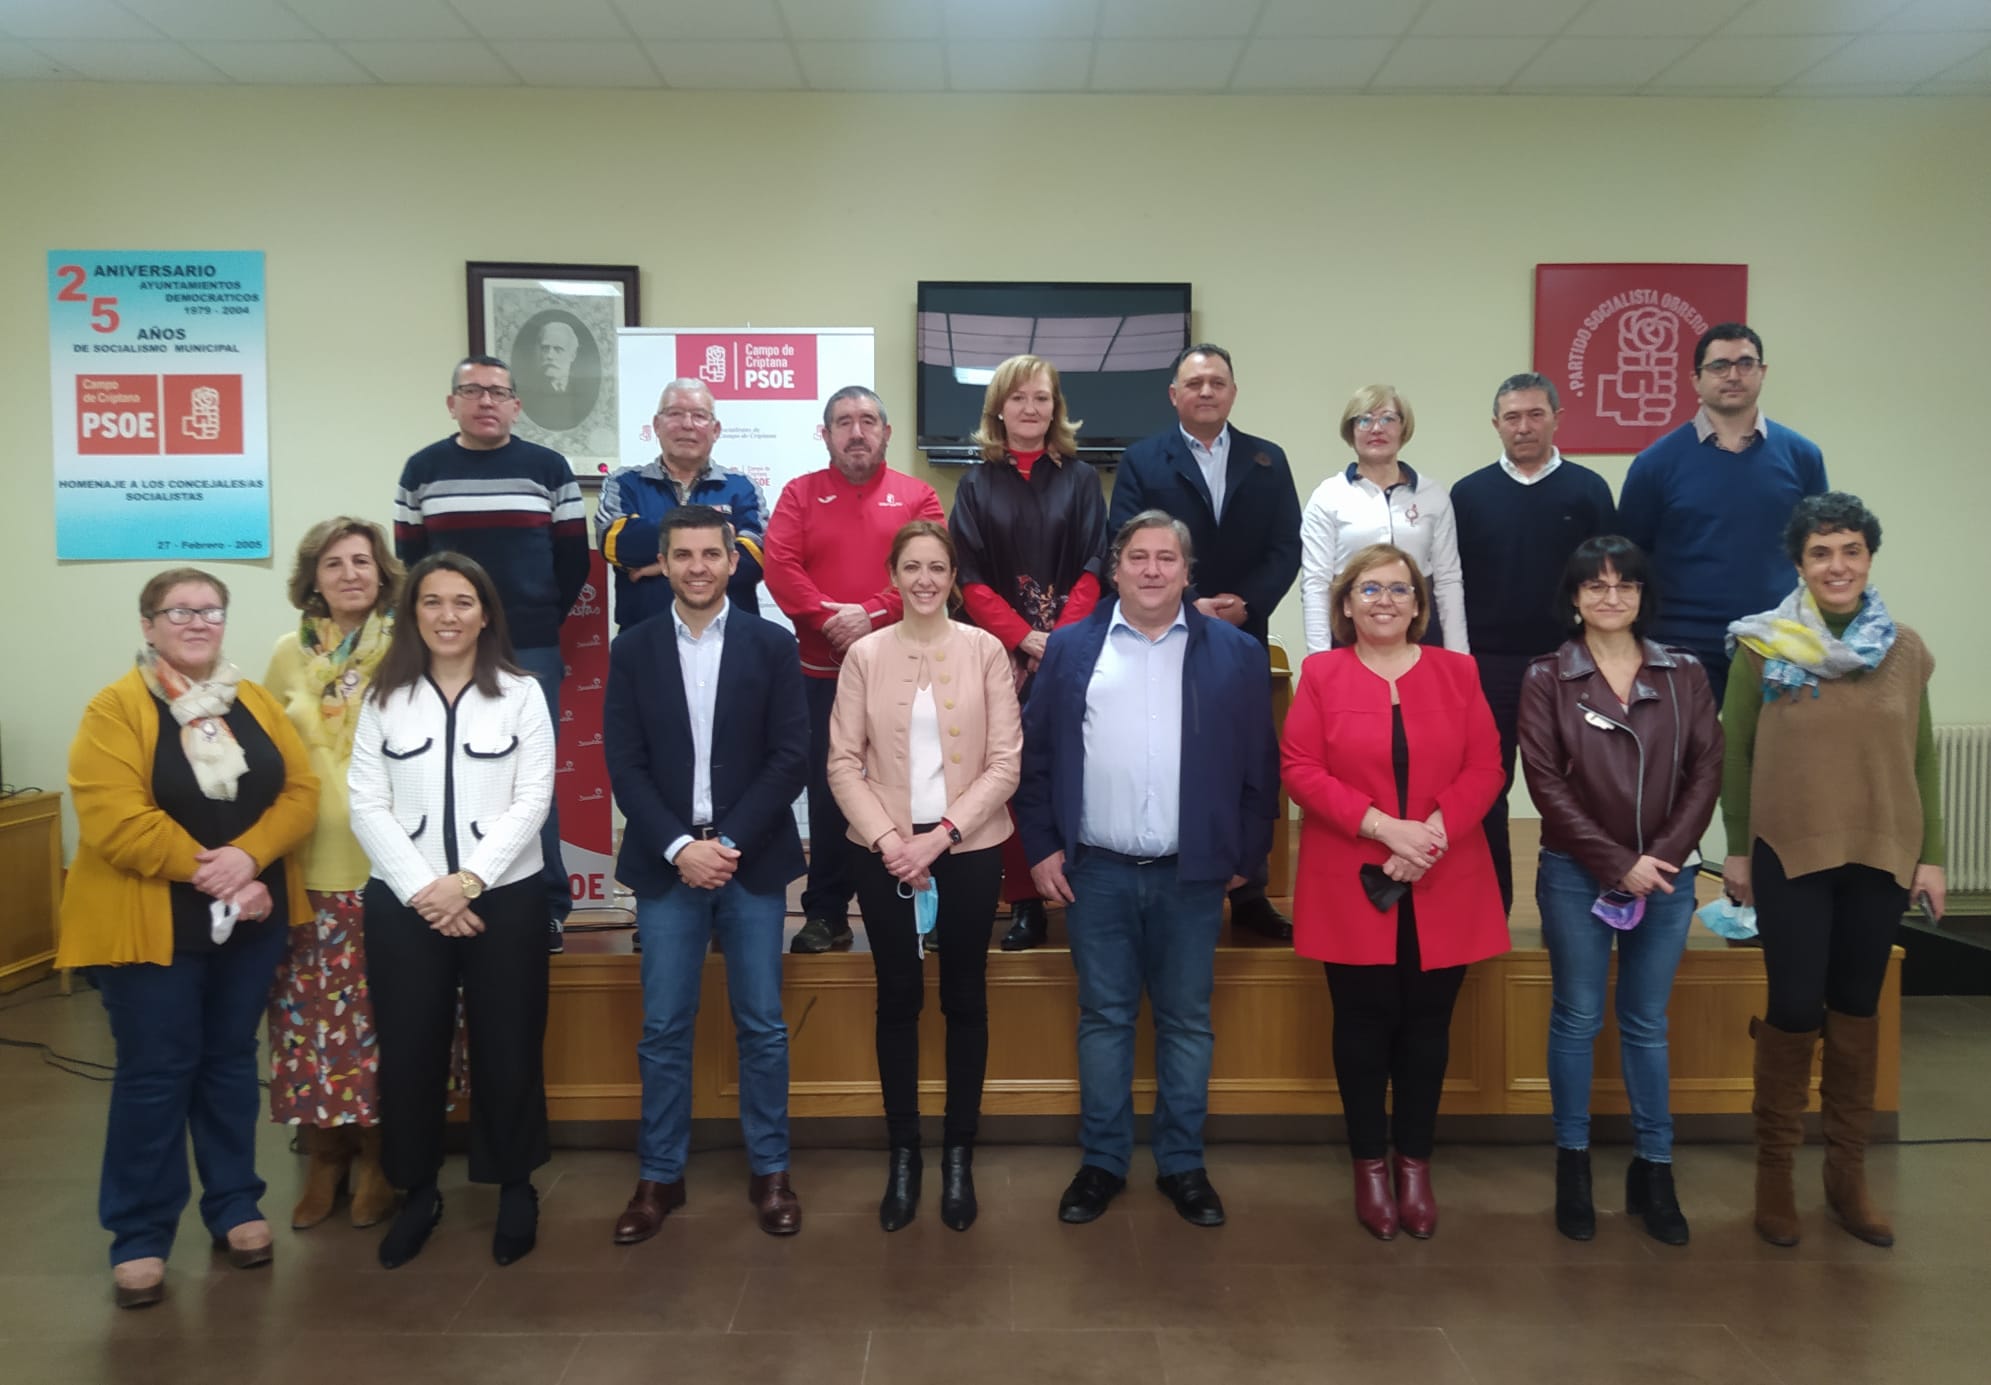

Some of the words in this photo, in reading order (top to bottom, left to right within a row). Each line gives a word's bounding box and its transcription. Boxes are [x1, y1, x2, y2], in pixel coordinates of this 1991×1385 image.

[94, 265, 217, 278] ANIVERSARIO
[57, 265, 88, 302] 2
[139, 281, 242, 290] AYUNTAMIENTOS
[165, 293, 260, 303] DEMOCRATICOS
[90, 296, 120, 333] 5
[184, 306, 211, 315] 1979
[222, 306, 250, 315] 2004
[137, 326, 187, 341] AÑOS
[1568, 327, 1593, 392] PARTIDO
[1583, 289, 1659, 331] SOCIALISTA
[1660, 293, 1710, 336] OBRERO
[73, 344, 88, 353] DE
[94, 344, 168, 353] SOCIALISMO
[174, 344, 240, 353] MUNICIPAL
[745, 343, 779, 356] Campo
[782, 344, 795, 356] de
[745, 356, 788, 369] Criptana
[82, 379, 119, 391] Campo
[744, 370, 796, 389] PSOE
[83, 393, 97, 403] de
[99, 393, 141, 405] Criptana
[82, 412, 156, 439] PSOE
[58, 480, 126, 489] HOMENAJE
[131, 480, 138, 488] A
[143, 480, 165, 489] LOS
[125, 493, 204, 501] SOCIALISTAS
[157, 541, 170, 550] 27
[181, 541, 225, 550] Febrero
[236, 541, 263, 549] 2005
[567, 873, 606, 900] OE
